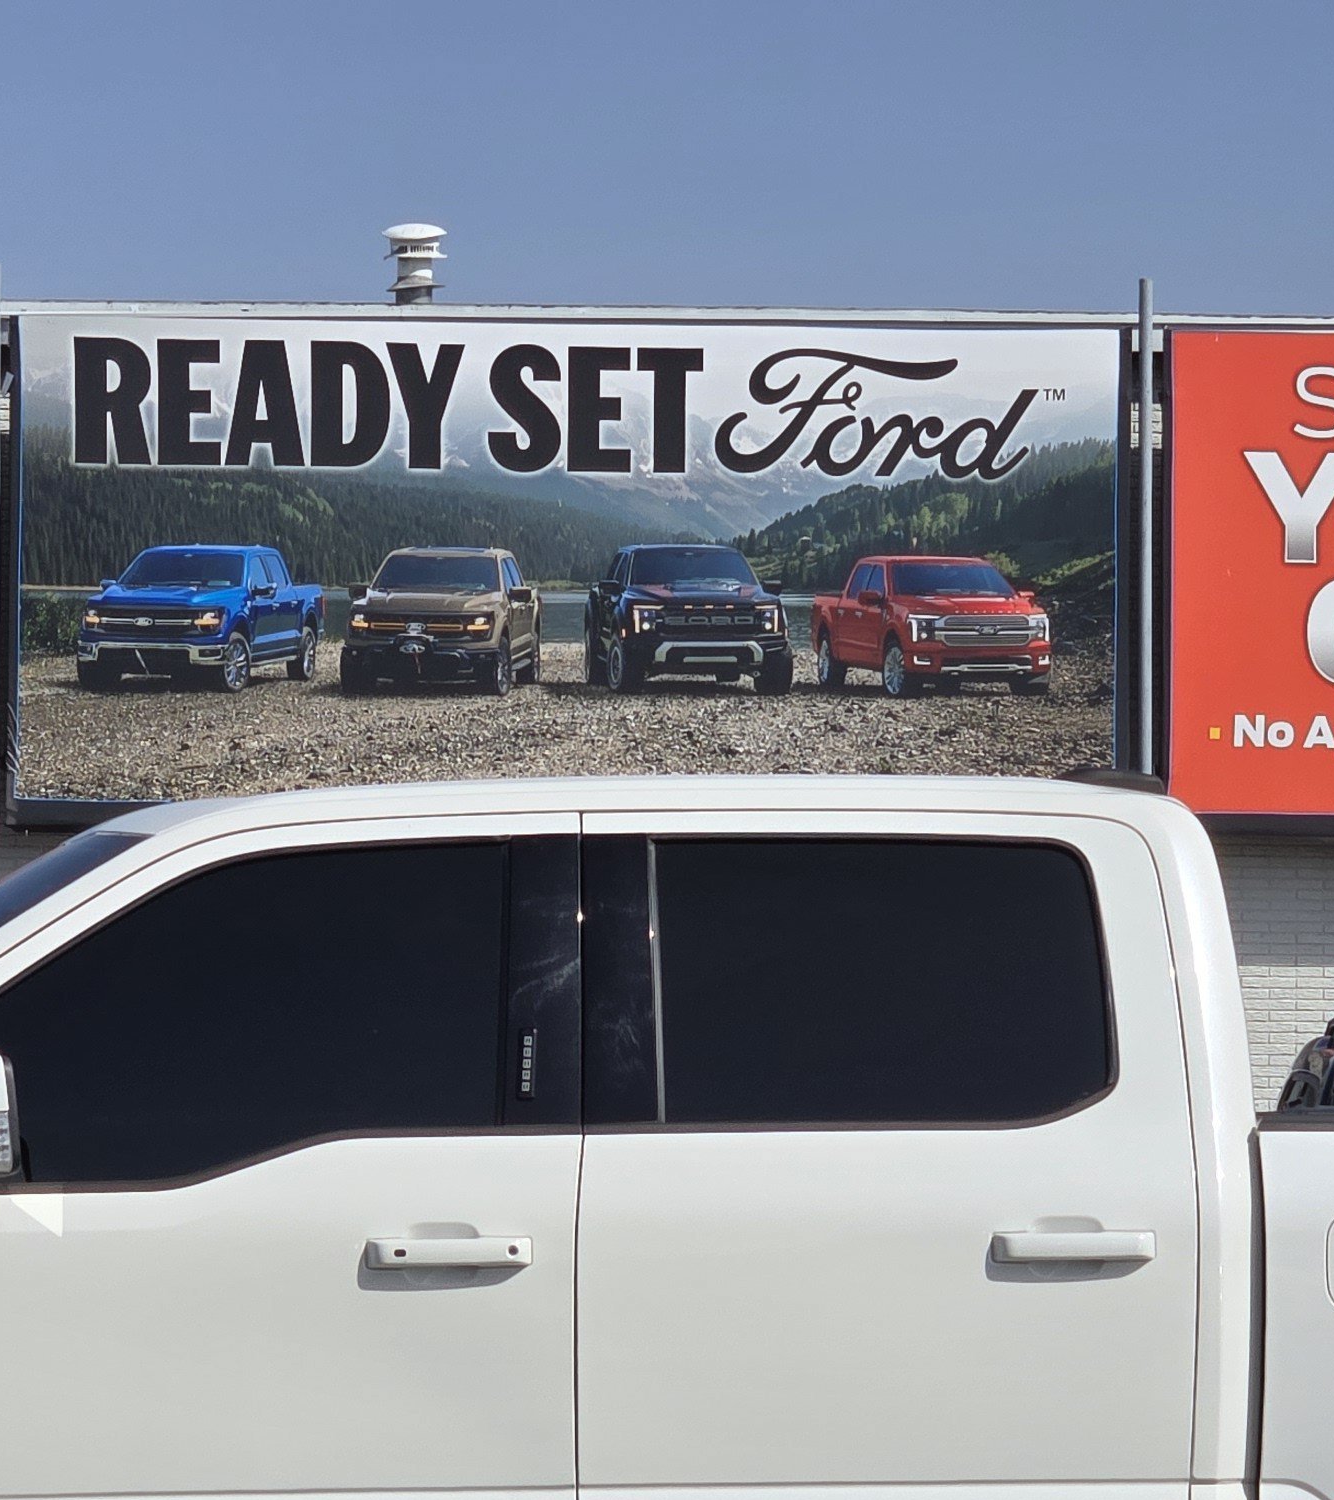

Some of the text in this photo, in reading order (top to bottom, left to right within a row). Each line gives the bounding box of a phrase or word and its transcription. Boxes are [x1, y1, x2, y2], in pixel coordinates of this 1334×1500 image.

[73, 336, 465, 470] READY
[488, 344, 704, 474] SET
[714, 348, 1040, 480] Ford
[1233, 714, 1295, 748] No
